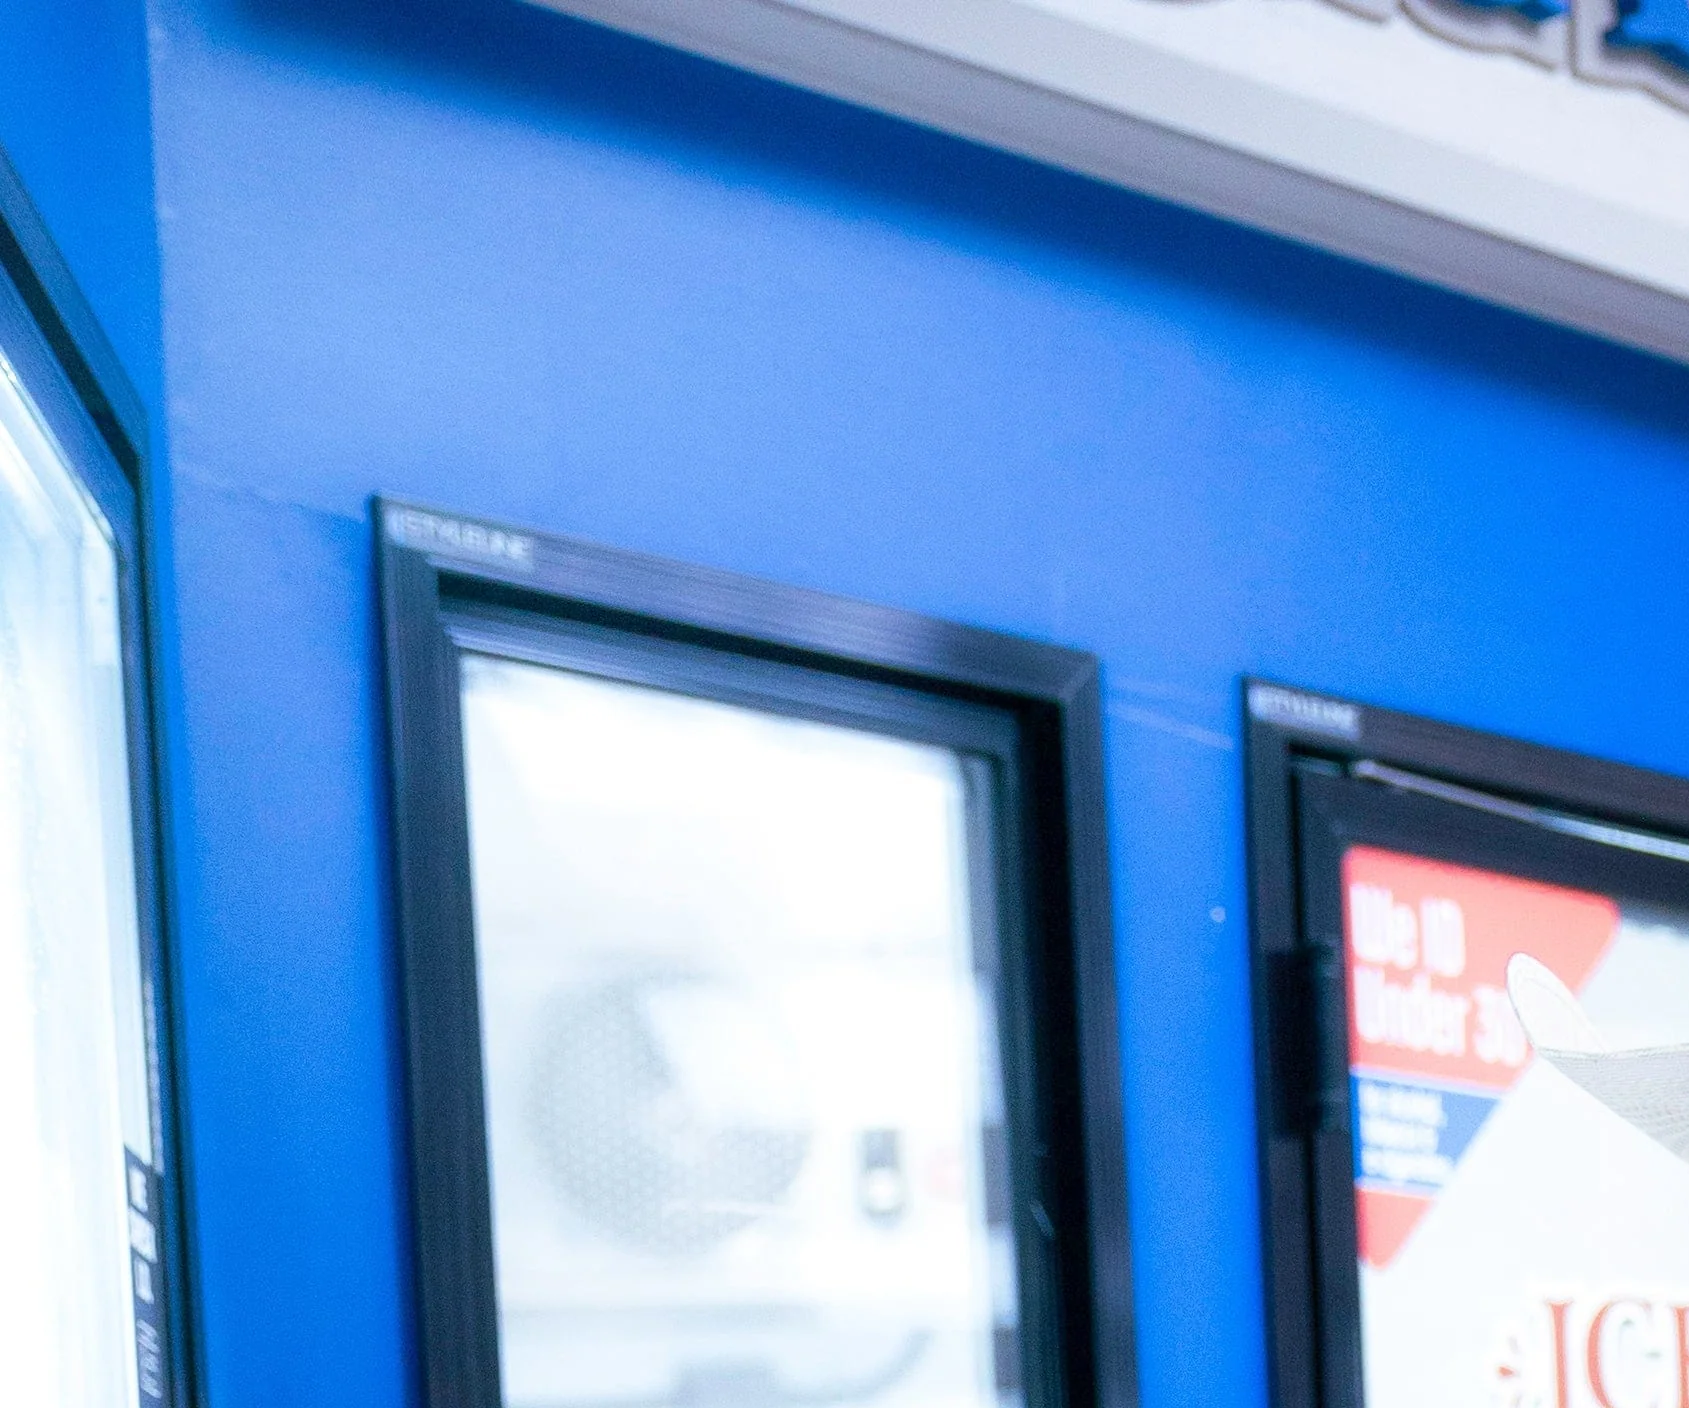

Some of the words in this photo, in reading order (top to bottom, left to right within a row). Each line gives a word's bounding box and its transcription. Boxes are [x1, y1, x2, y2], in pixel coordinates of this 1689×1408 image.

[1350, 883, 1417, 970] We
[1419, 898, 1467, 979] ID
[1353, 965, 1471, 1058] Under
